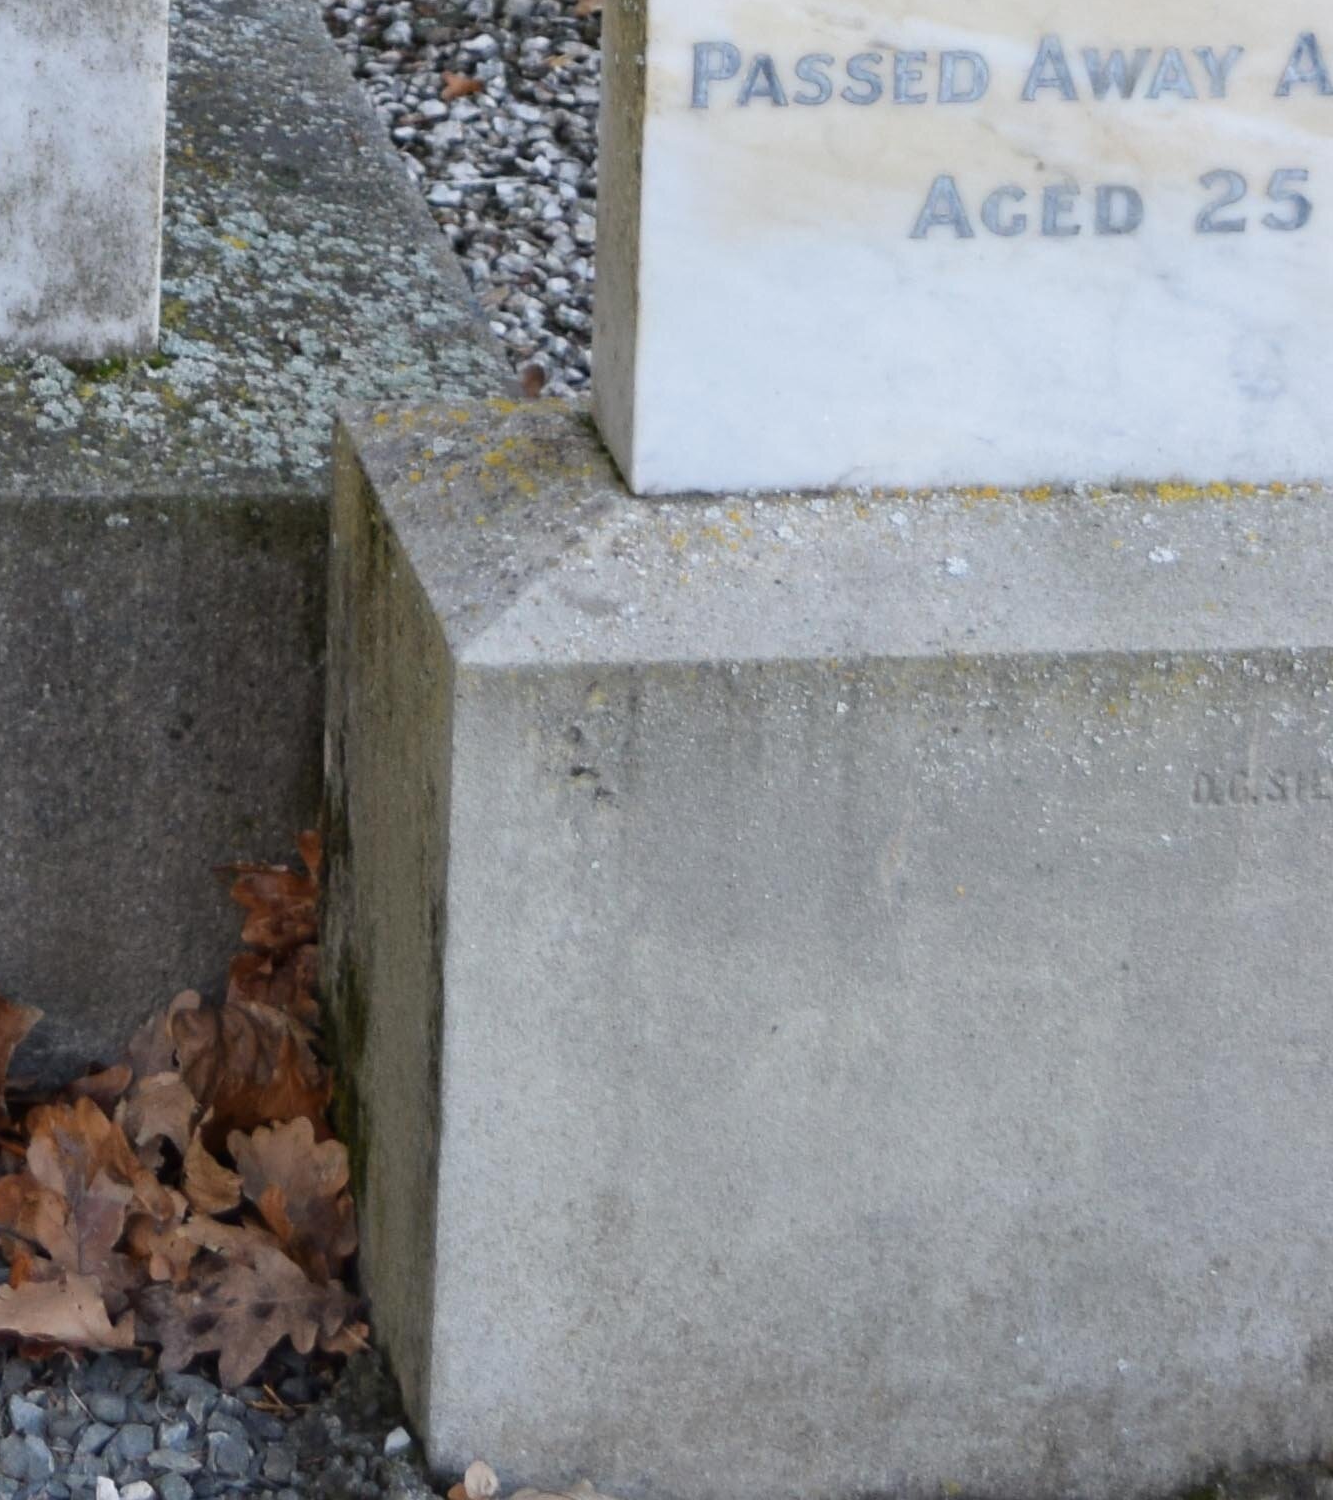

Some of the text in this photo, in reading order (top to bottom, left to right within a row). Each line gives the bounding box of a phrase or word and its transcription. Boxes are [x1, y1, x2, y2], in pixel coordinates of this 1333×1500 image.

[691, 41, 990, 108] PASSED
[1023, 35, 1245, 100] AWAY
[909, 168, 1313, 238] AGED 25
